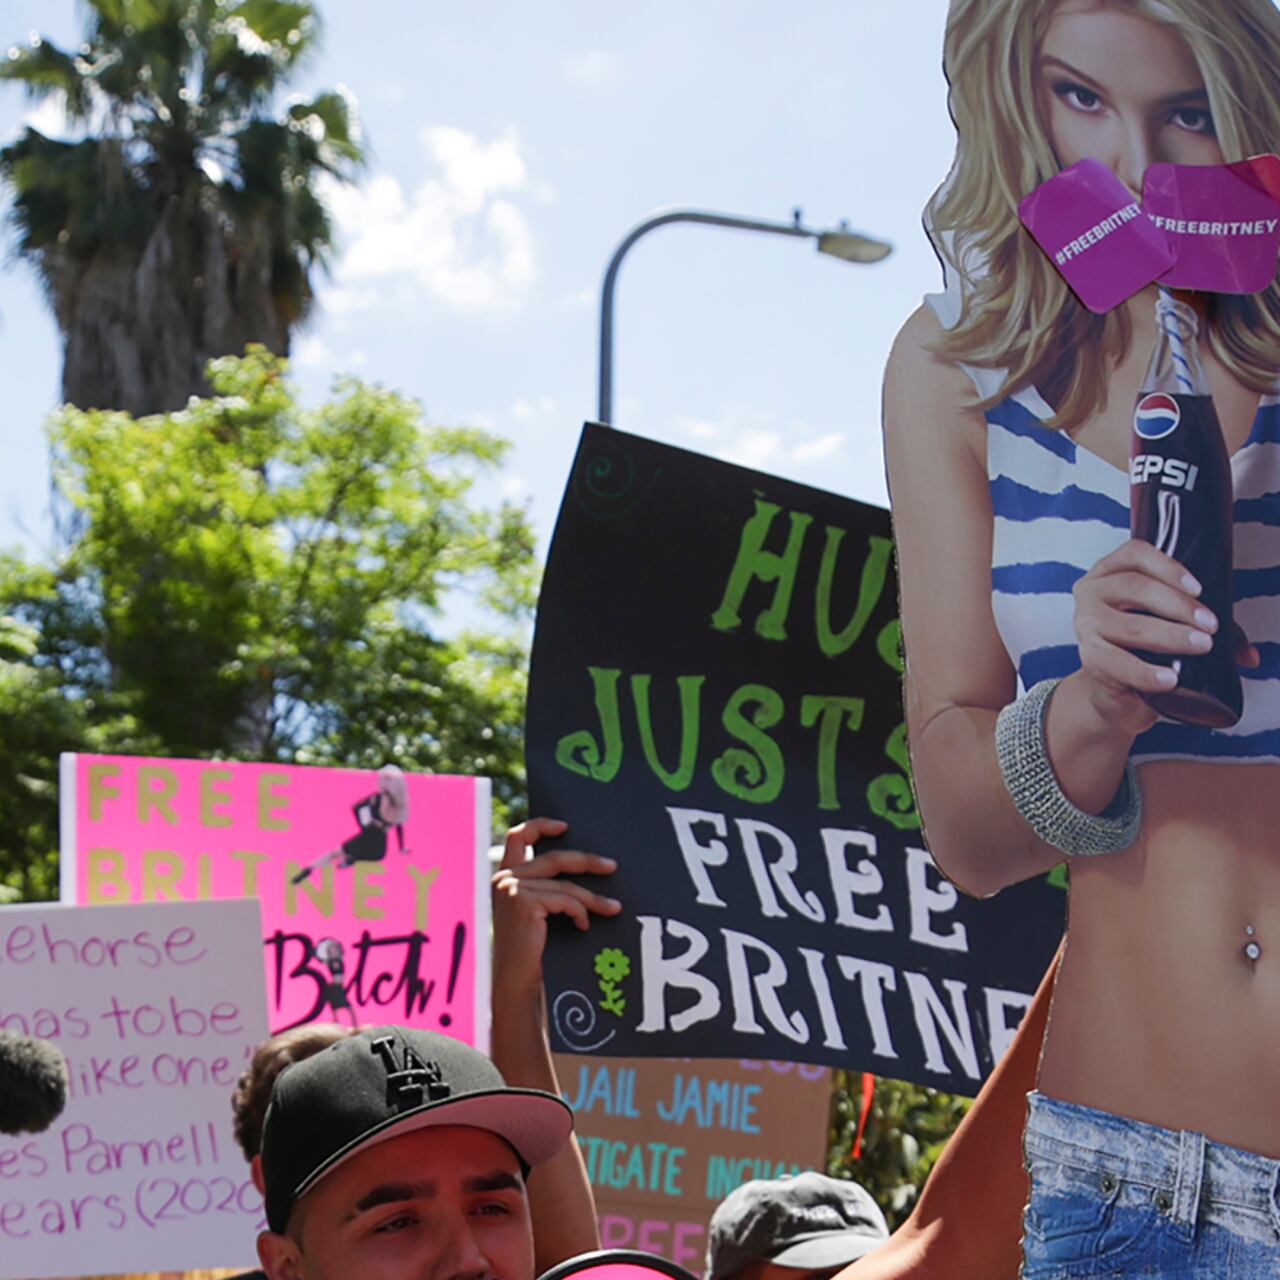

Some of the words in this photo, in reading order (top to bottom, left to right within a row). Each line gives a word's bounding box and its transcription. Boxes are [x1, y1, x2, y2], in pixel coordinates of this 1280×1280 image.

[1055, 202, 1142, 266] #FREEBRITNEY
[1130, 454, 1199, 492] EPSI
[89, 764, 292, 832] FREE
[89, 848, 442, 932] BRITNEY
[664, 805, 971, 954] FREE
[634, 915, 1036, 1081] BRITNE
[371, 1035, 450, 1114] LA
[563, 1064, 640, 1119] JAIL
[656, 1073, 763, 1135] JAMIE
[61, 1122, 221, 1176] Parnell
[577, 1134, 687, 1196] TIGATE
